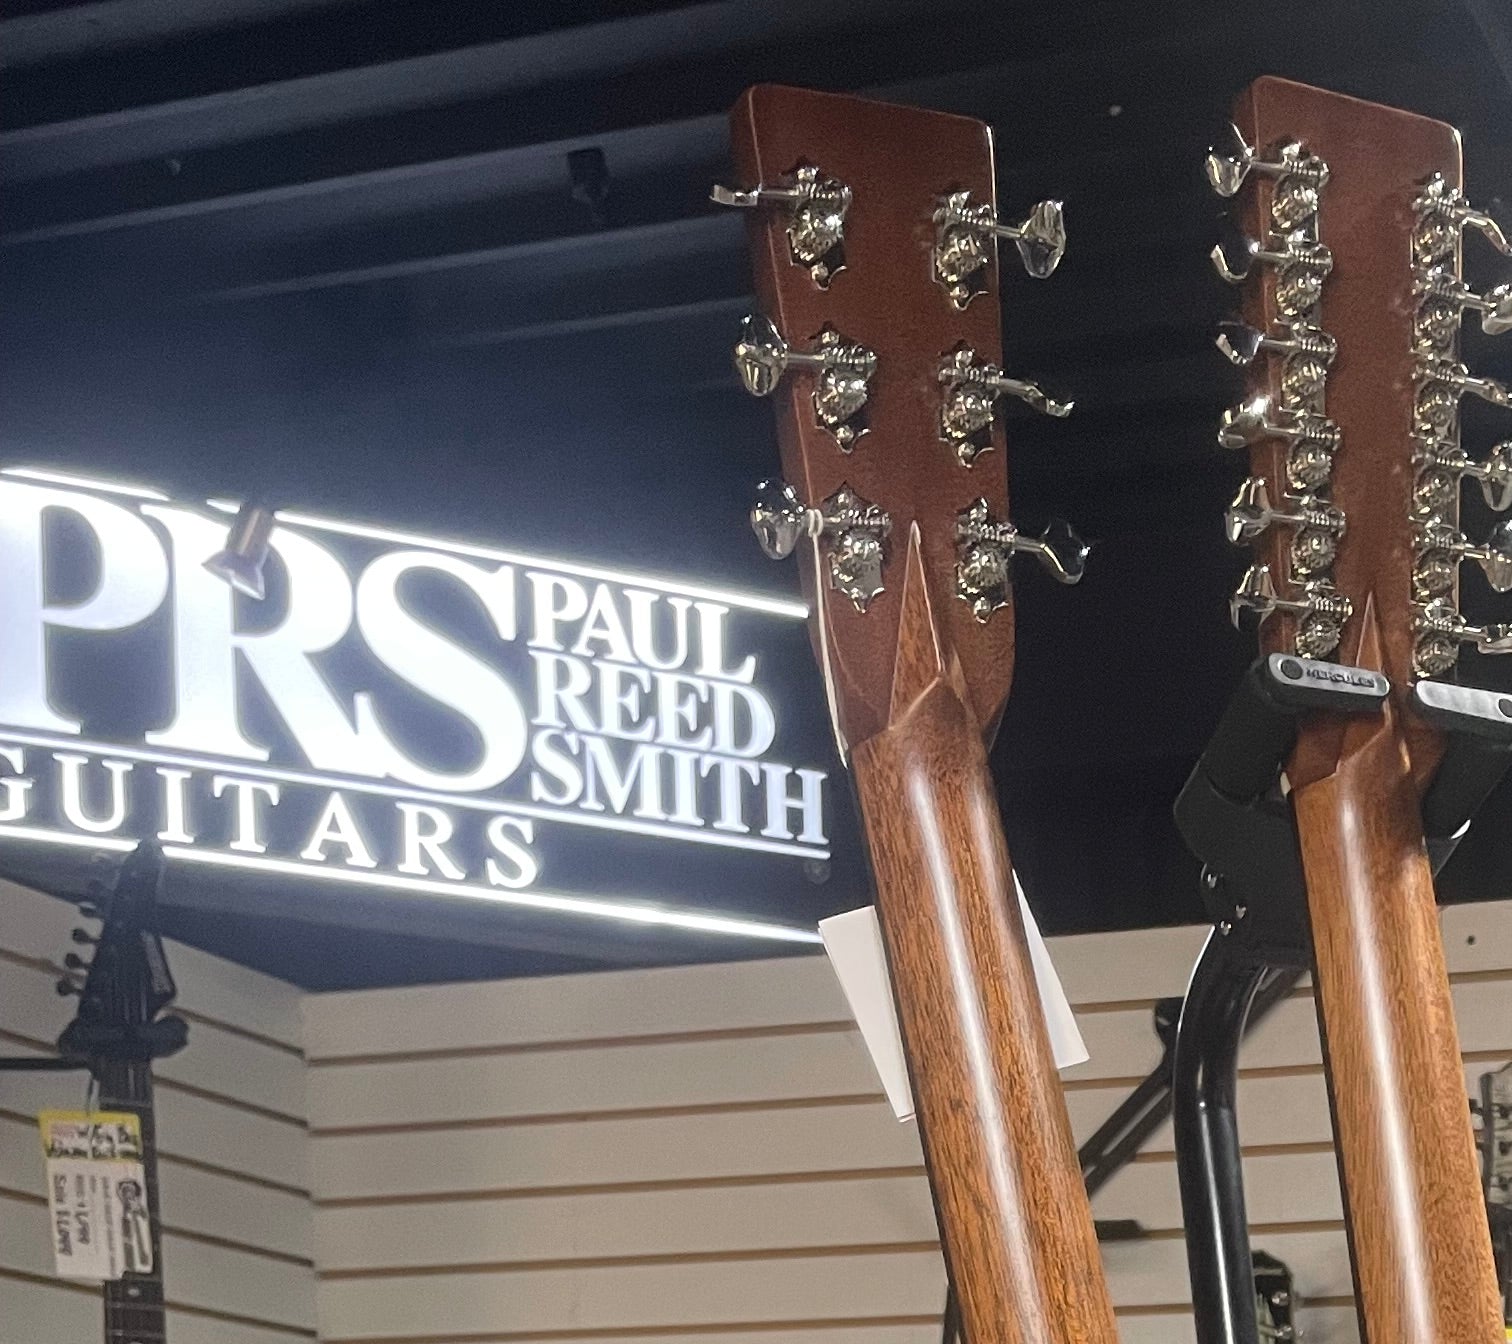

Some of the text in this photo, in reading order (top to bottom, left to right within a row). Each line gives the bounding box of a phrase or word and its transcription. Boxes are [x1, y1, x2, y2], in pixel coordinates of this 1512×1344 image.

[0, 482, 529, 792] PRS
[527, 570, 757, 685] PAUL
[529, 648, 777, 760] REED
[531, 728, 831, 847] SMITH
